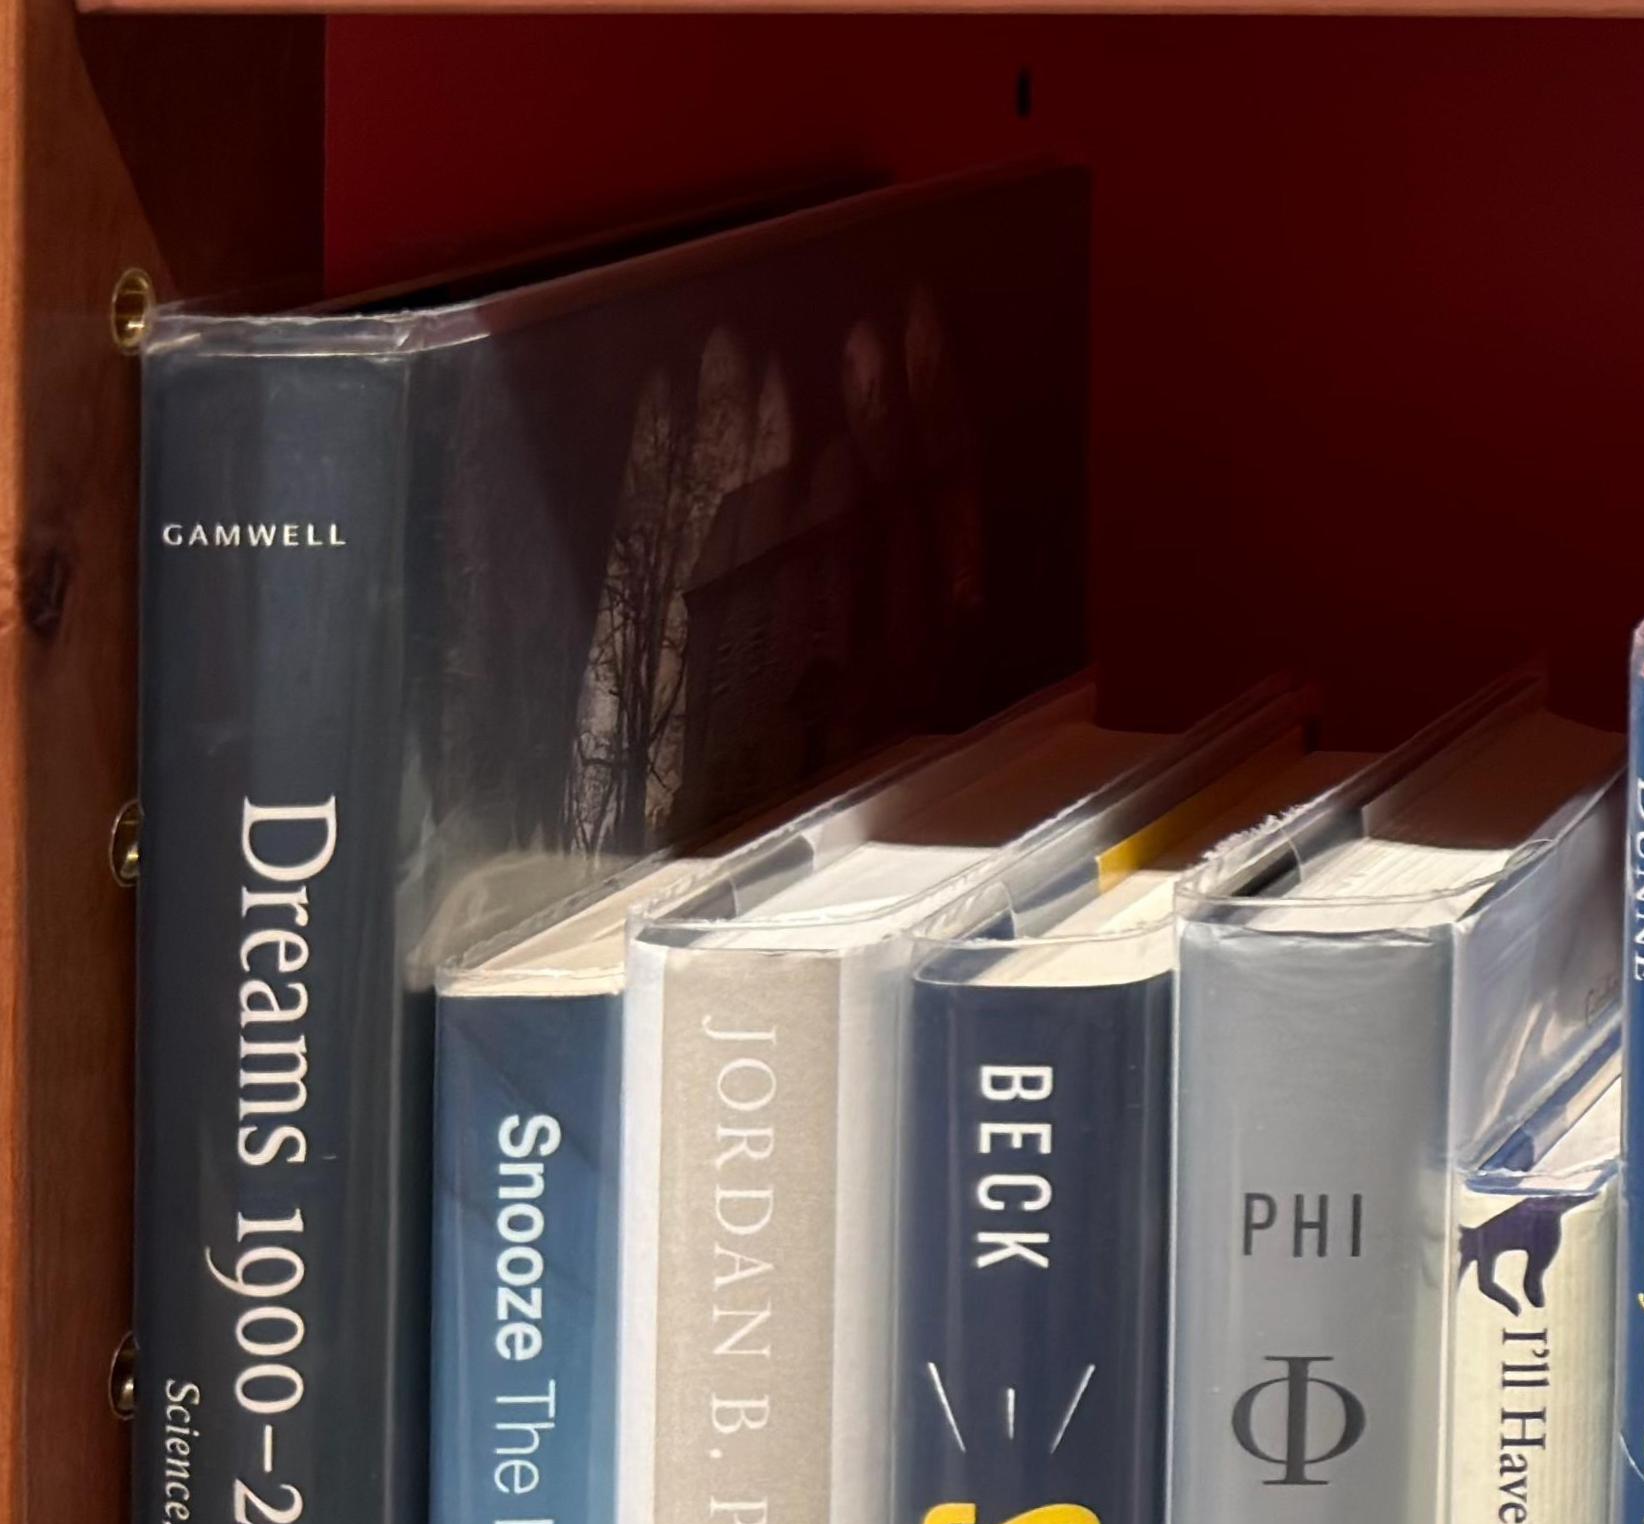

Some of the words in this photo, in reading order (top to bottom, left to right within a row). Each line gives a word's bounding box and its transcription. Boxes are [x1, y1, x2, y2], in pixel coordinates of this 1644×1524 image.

[162, 522, 347, 547] GAMWELL
[237, 796, 336, 1166] Dreams
[703, 1017, 777, 1361] JORDAN
[975, 1065, 1053, 1269] BECK
[1243, 1192, 1363, 1258] PHI
[492, 1114, 561, 1361] Snooze
[492, 1381, 555, 1494] The
[709, 1394, 770, 1459] B.
[1497, 1407, 1547, 1524] Have
